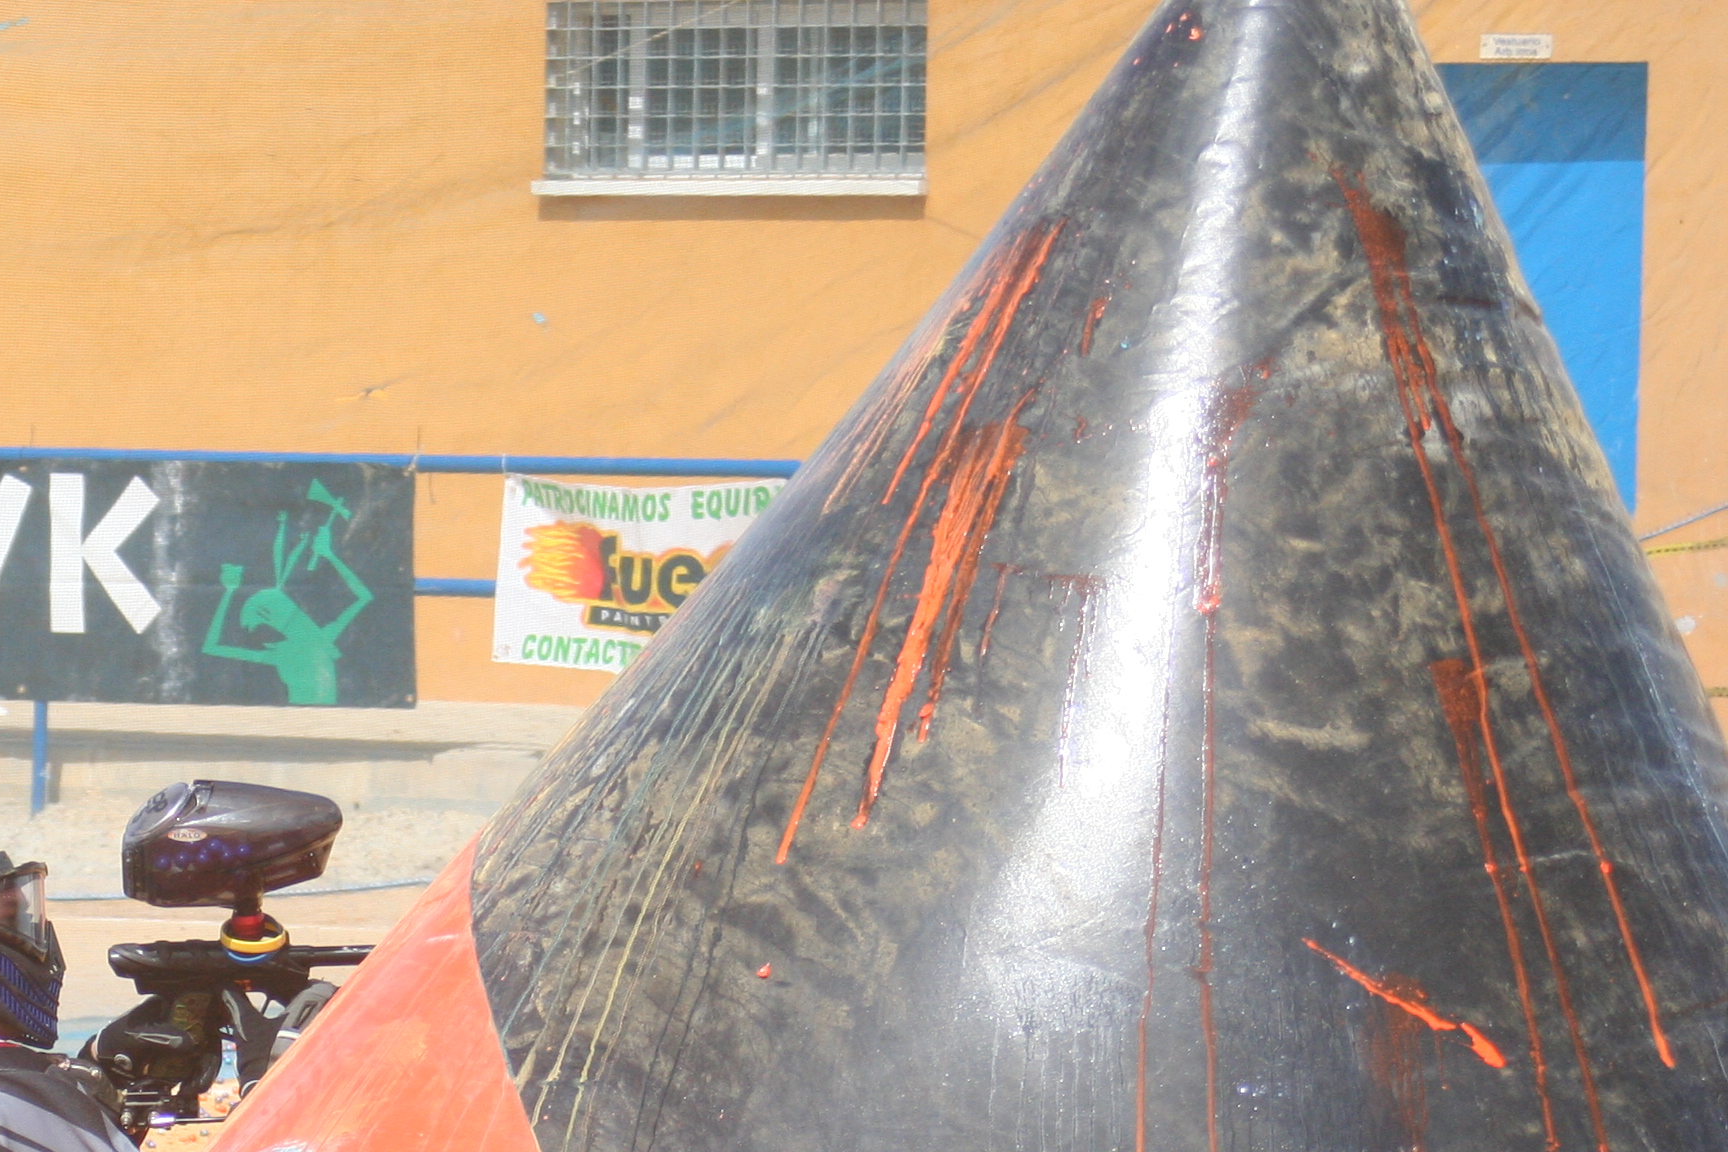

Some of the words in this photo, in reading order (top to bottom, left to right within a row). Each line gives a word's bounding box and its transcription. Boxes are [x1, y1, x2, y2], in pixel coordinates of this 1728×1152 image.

[522, 478, 671, 522] PATROCINAMOS
[691, 485, 781, 521] EQUIP
[598, 534, 710, 608] fue
[173, 830, 201, 839] HALO
